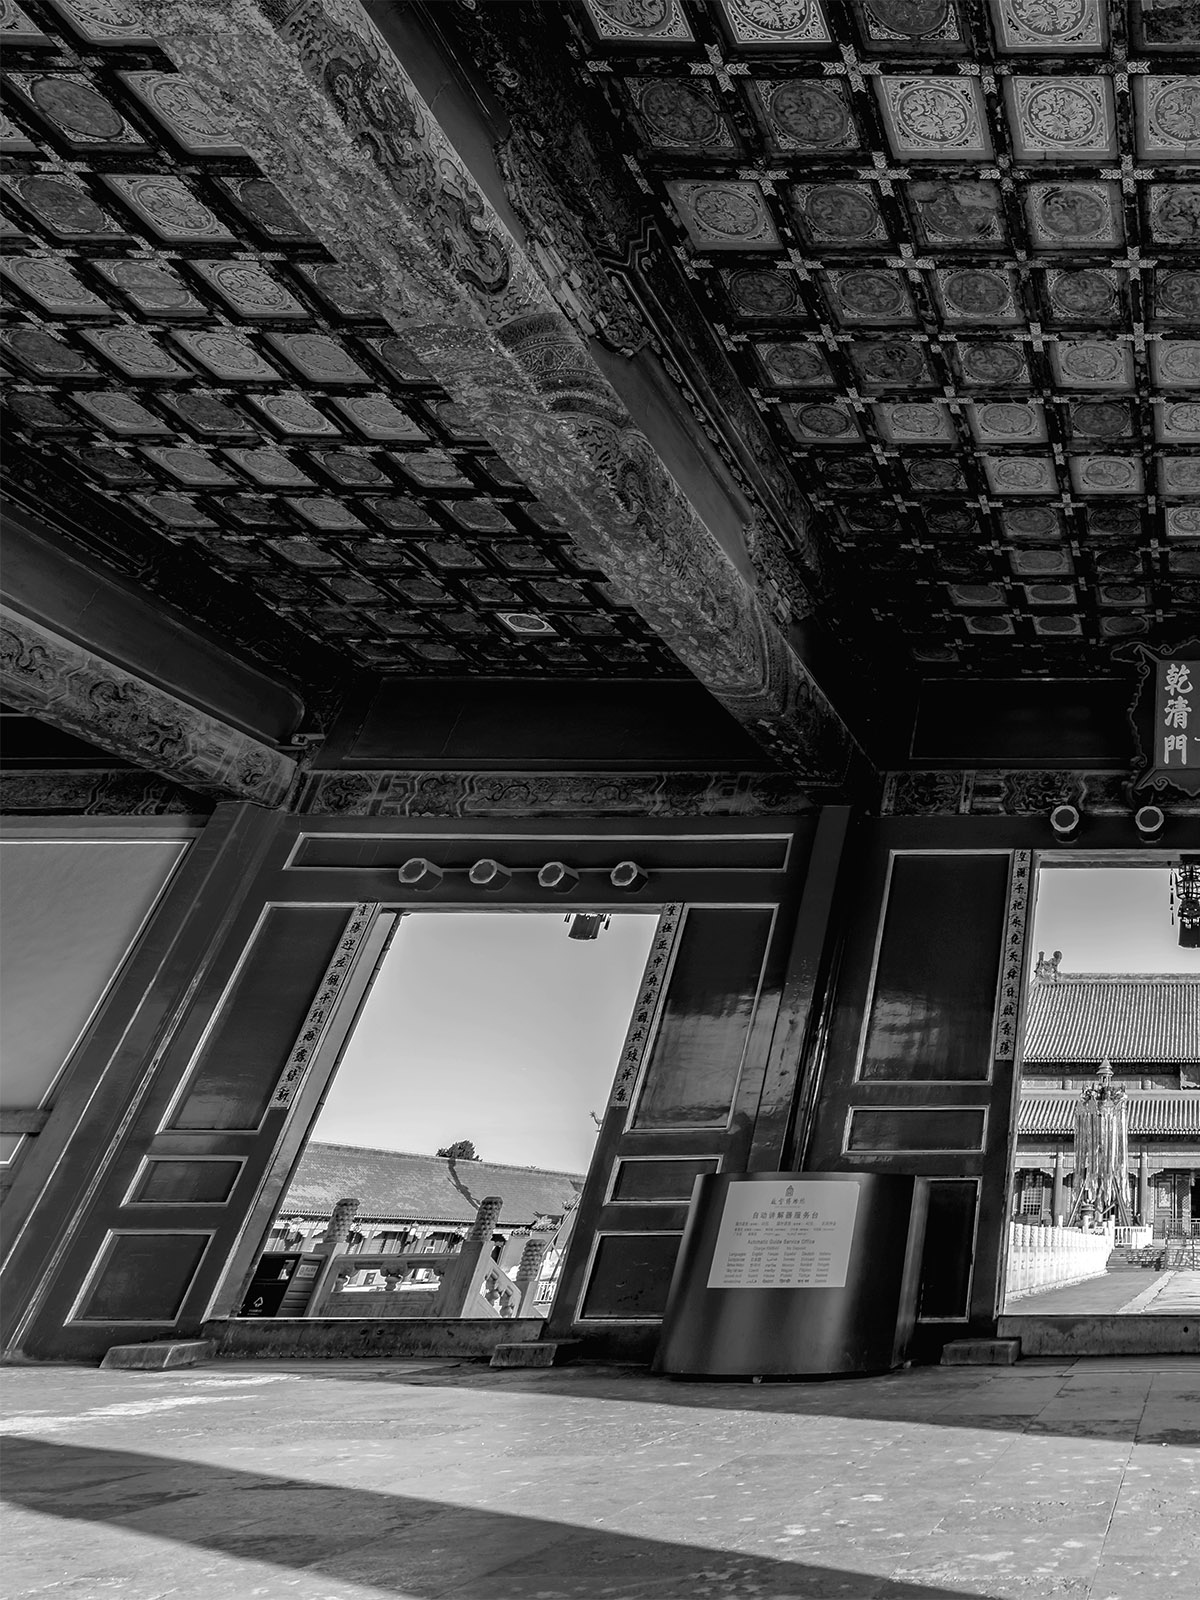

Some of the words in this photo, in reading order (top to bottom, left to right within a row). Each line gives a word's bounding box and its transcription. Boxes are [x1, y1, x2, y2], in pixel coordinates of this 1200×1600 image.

[1164, 663, 1194, 765] 乾清門
[752, 1211, 819, 1219] 自动讲解器服务台
